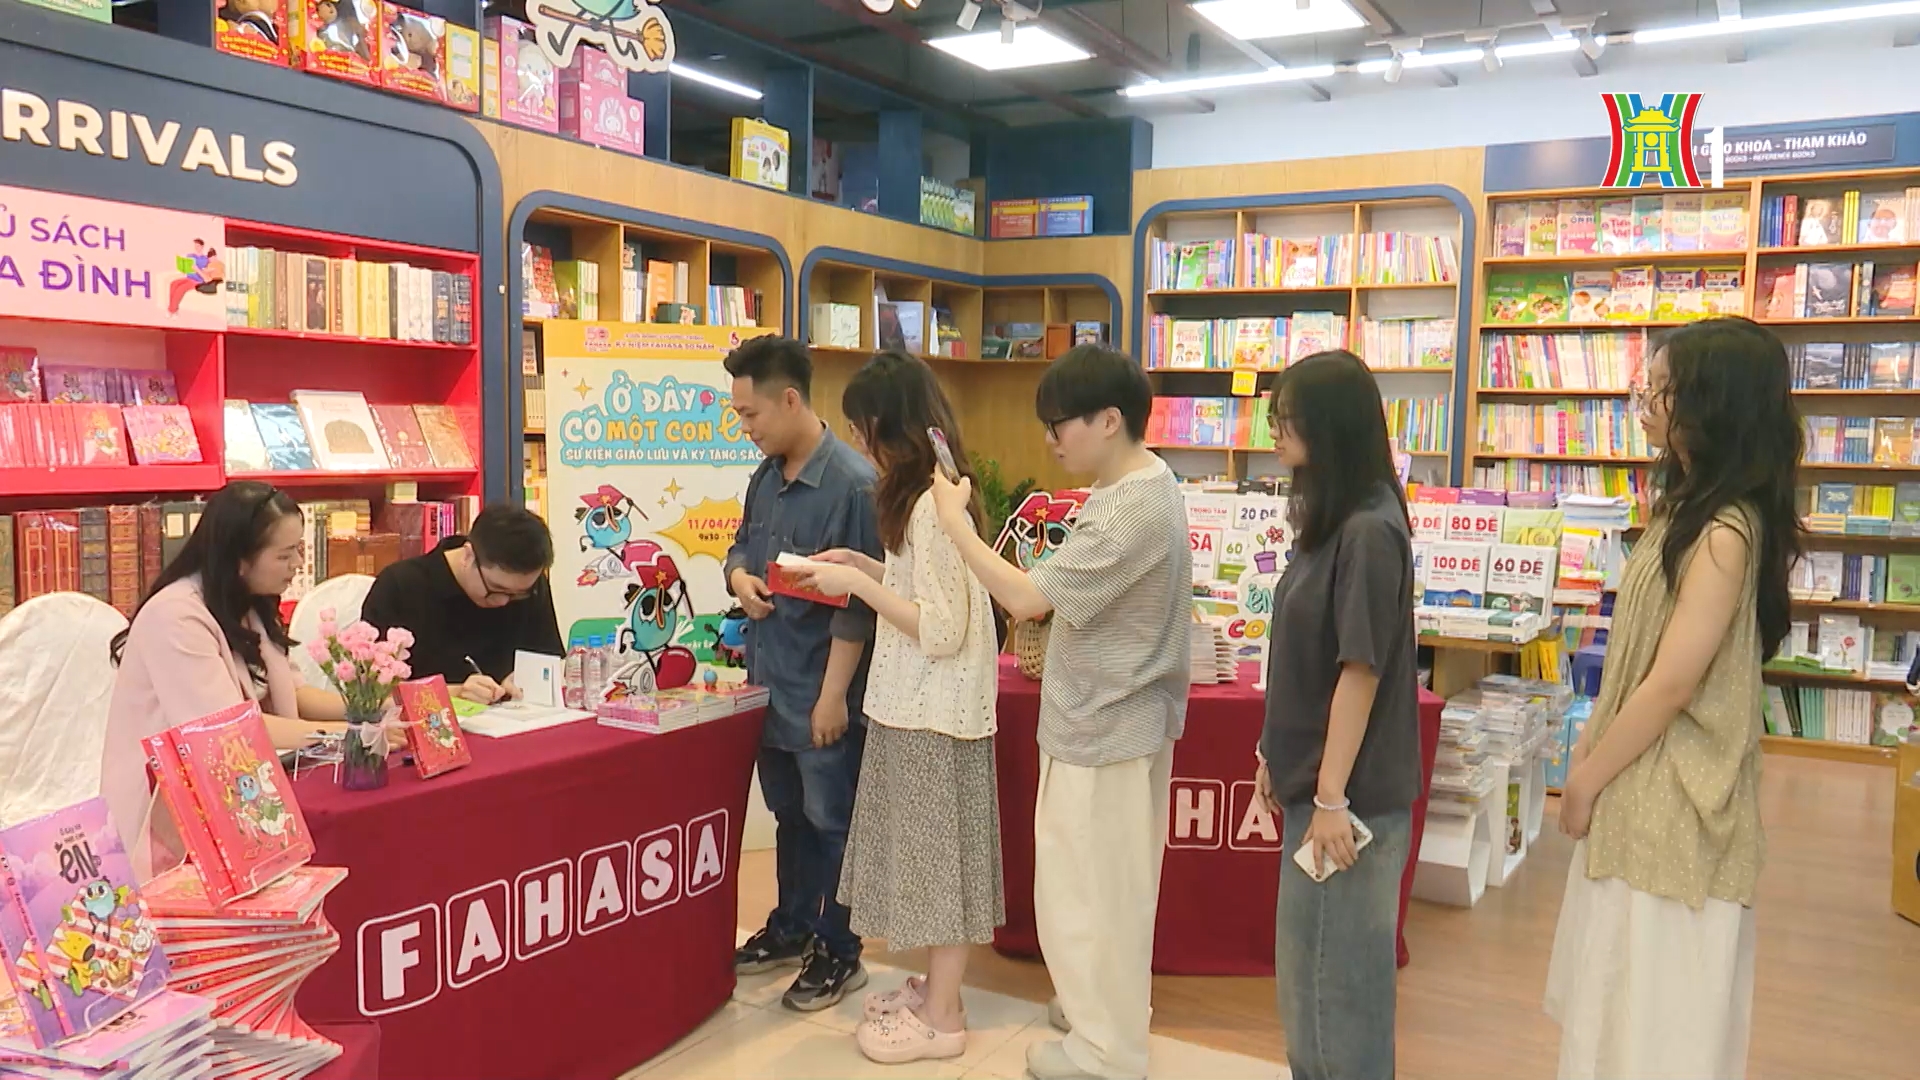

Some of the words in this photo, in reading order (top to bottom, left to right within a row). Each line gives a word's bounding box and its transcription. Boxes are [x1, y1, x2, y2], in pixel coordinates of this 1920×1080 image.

[1, 88, 299, 187] RRIVALS
[1735, 139, 1773, 154] KHOA
[1783, 135, 1825, 151] THAM
[1827, 129, 1867, 147] KHẢO
[30, 214, 126, 252] SÁCH
[0, 255, 25, 288] A
[38, 254, 151, 299] ĐÌNH
[611, 374, 632, 413] Ở
[641, 381, 697, 413] ĐÂY
[563, 409, 603, 443] CÓ
[606, 413, 660, 449] MỘT
[664, 420, 713, 443] CON
[615, 448, 644, 461] GIAO
[646, 447, 670, 460] LƯU
[672, 446, 689, 460] VÀ
[690, 446, 706, 460] KÝ
[739, 446, 768, 460] SÁC
[1240, 507, 1257, 520] 20
[1451, 515, 1471, 530] 80
[1225, 542, 1244, 555] 60
[1433, 555, 1458, 570] 100
[1493, 556, 1516, 572] 60
[381, 822, 721, 1001] FAHASA
